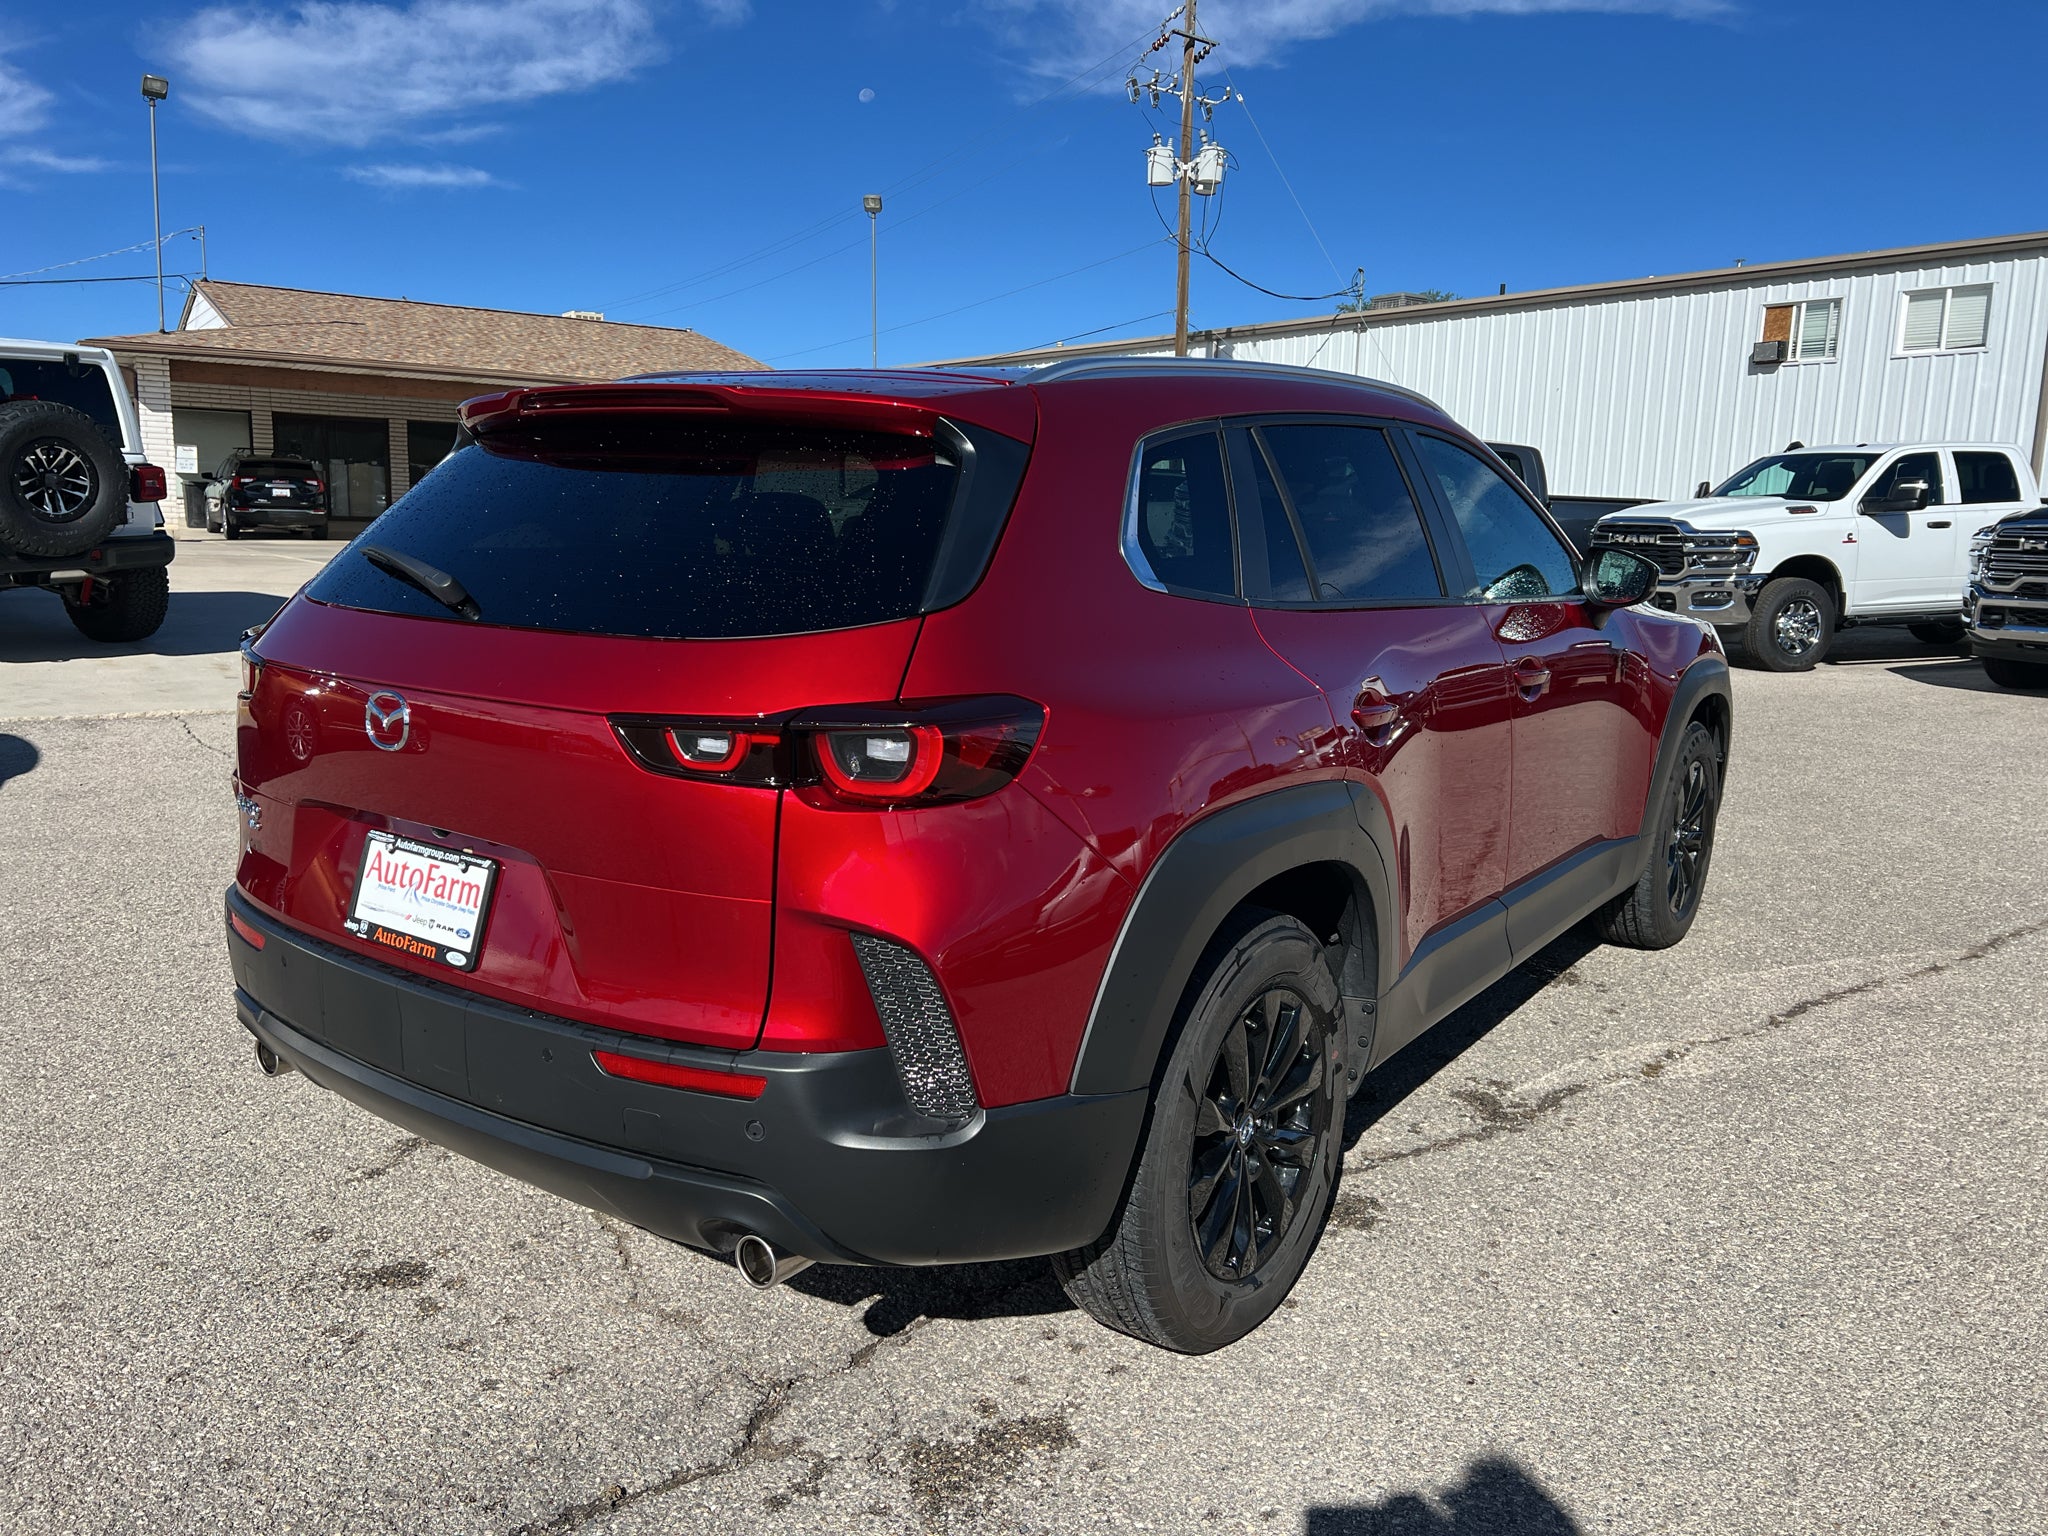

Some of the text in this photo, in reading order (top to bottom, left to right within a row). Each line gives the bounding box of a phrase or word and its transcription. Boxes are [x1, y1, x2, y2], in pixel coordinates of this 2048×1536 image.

[1613, 533, 1656, 543] RAM
[395, 838, 460, 863] Autofarmgroup.com
[365, 850, 480, 909] AutoFarm
[412, 914, 428, 926] Jeep
[436, 923, 454, 933] RAM
[373, 926, 437, 959] AutoFarm
